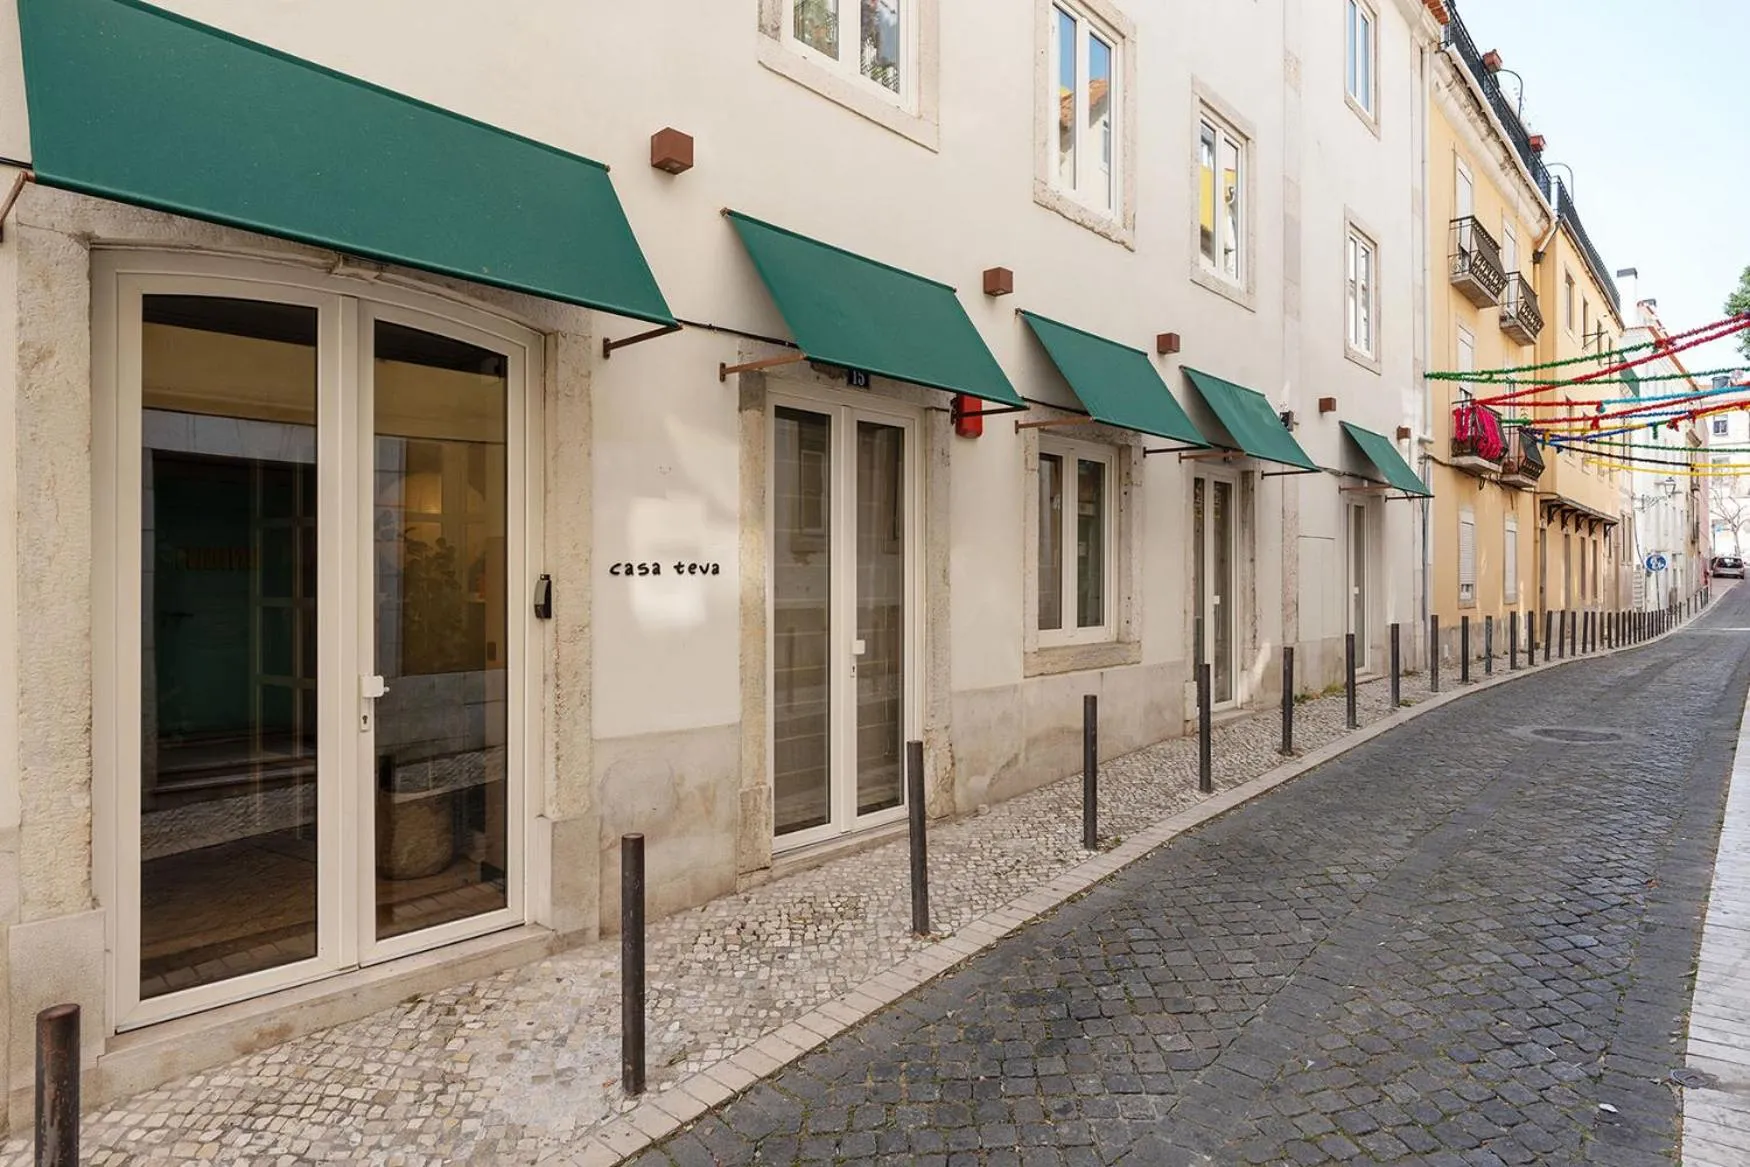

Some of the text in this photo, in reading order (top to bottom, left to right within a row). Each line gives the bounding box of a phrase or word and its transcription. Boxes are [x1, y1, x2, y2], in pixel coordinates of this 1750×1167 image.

[853, 370, 865, 385] 15
[609, 561, 720, 576] casa teva
